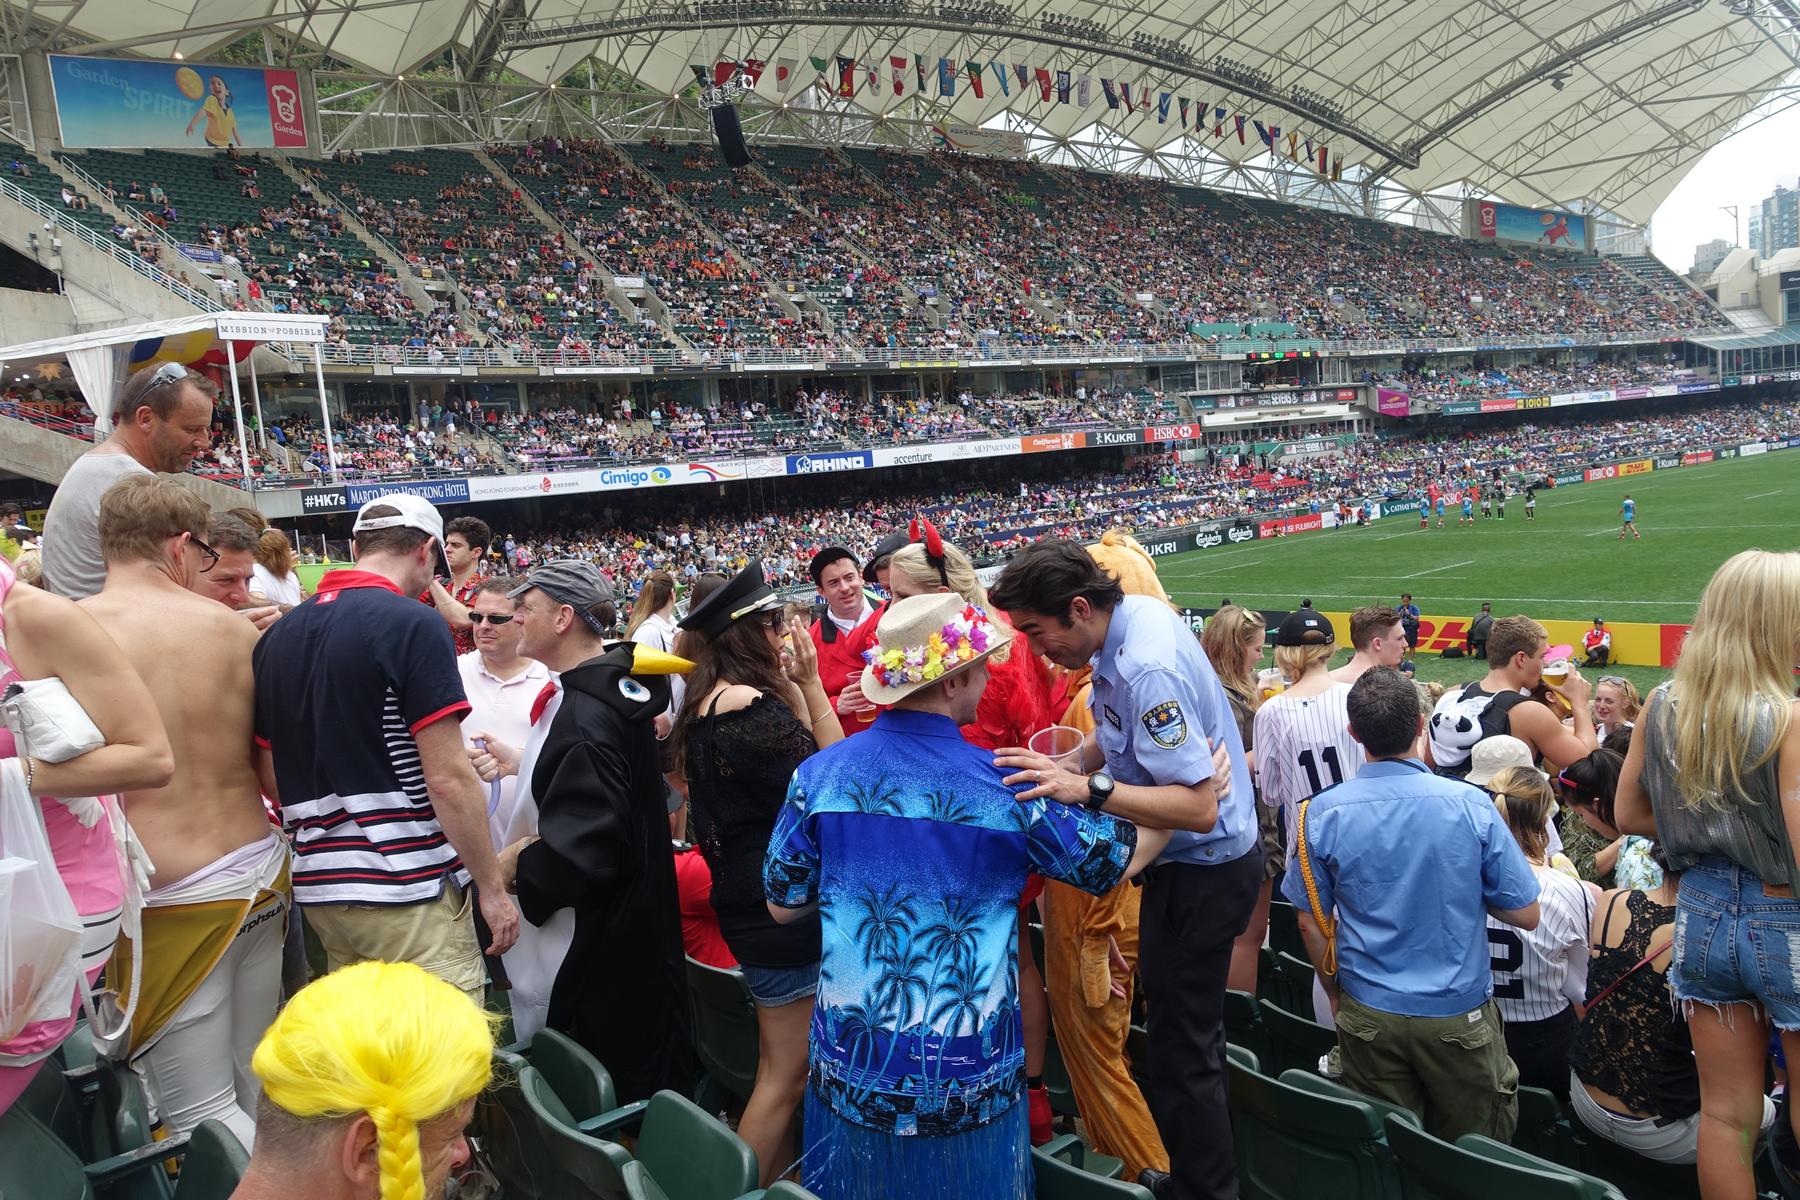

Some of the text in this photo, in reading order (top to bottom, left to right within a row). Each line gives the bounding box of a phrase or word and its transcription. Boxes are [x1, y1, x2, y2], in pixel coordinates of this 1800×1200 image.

[66, 61, 129, 90] Garden
[123, 86, 196, 122] SPIRIT
[274, 121, 304, 137] Garden
[969, 130, 989, 138] WORLD
[220, 326, 322, 336] MISSION POSSIBLE
[1526, 399, 1542, 408] 1010
[1104, 432, 1136, 444] KUKRI
[1153, 427, 1178, 440] HSBC
[1032, 437, 1061, 446] California
[812, 456, 865, 472] RHINO
[893, 452, 933, 465] accenture
[1661, 458, 1680, 468] KUKRI
[1589, 468, 1606, 480] HSBC
[1626, 462, 1646, 473] DHL
[600, 468, 648, 491] Cimigo
[350, 488, 379, 504] MARCO
[445, 483, 468, 497] HOTEL
[304, 493, 346, 508] #HK7s
[1390, 503, 1410, 513] CATHAY
[1295, 520, 1321, 532] FULBRIGHT
[1195, 531, 1222, 549] Carlsberg
[1228, 526, 1253, 543] Carlsberg
[1143, 541, 1177, 556] UKRI
[1298, 746, 1344, 793] 11
